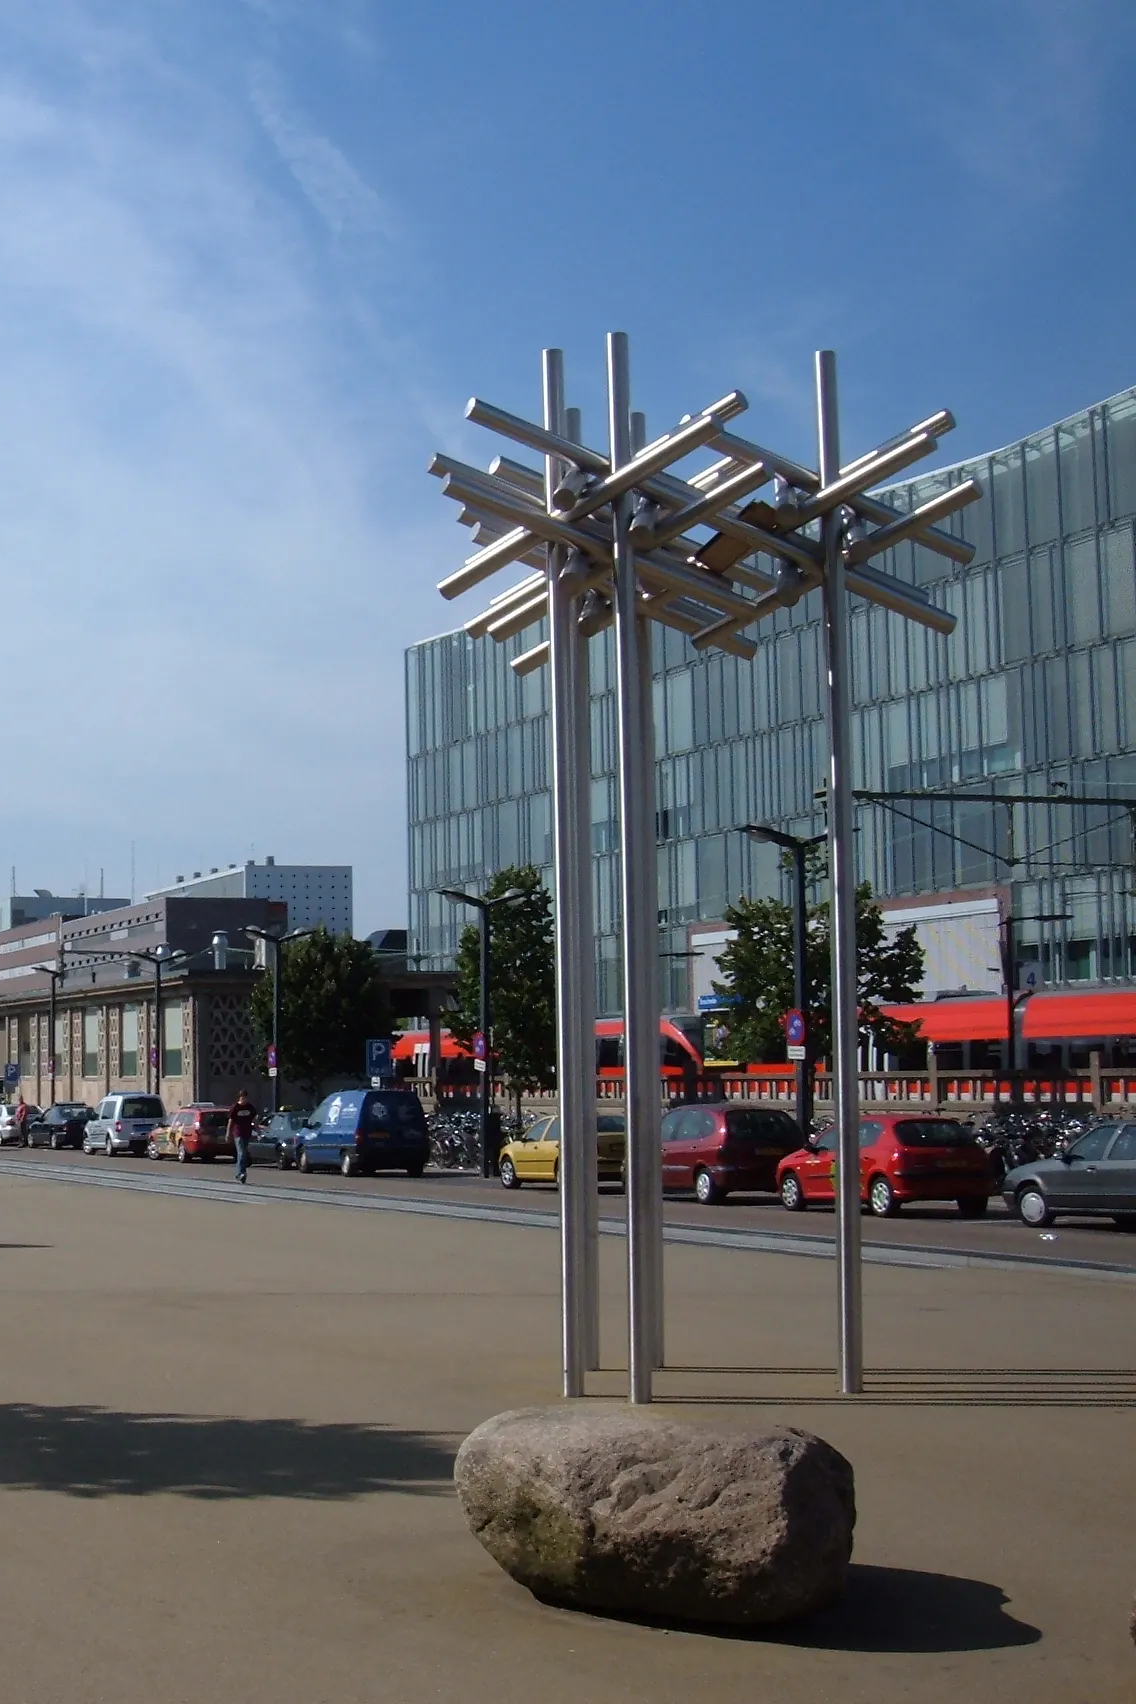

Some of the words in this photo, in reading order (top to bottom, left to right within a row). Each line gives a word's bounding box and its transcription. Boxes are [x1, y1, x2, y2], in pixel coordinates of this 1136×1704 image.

[1026, 972, 1036, 987] 4
[373, 1043, 386, 1061] P
[7, 1066, 15, 1076] P
